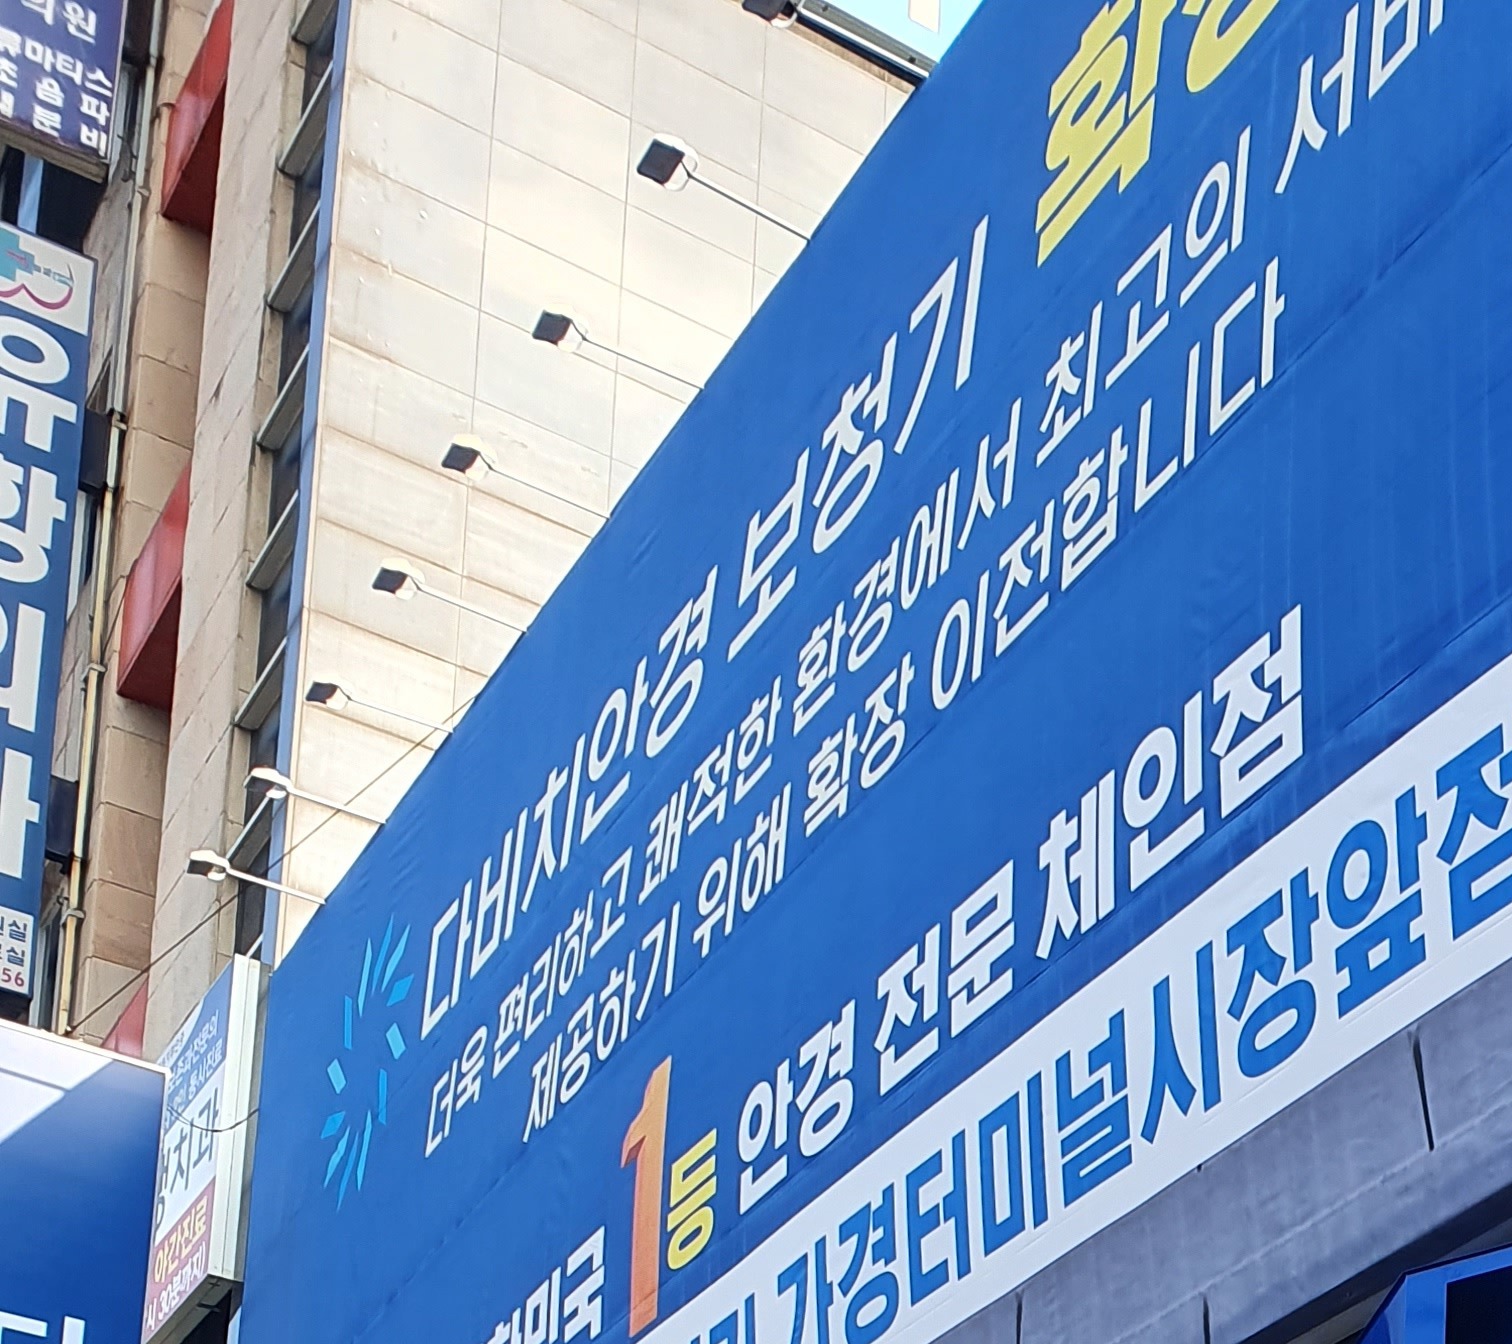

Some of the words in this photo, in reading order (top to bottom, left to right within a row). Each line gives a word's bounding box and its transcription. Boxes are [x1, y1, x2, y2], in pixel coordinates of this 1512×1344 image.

[420, 565, 718, 1040] 다비치안경
[727, 215, 990, 660] 보청기
[425, 1018, 489, 1159] 더욱
[491, 845, 633, 1080] 편리하고
[636, 672, 781, 904] 쾌적한
[791, 418, 1022, 739] 환경에서
[1034, 127, 1252, 464] 최고의
[521, 914, 679, 1144] 제공하기
[691, 780, 791, 961] 위해
[804, 662, 916, 837] 확장
[930, 256, 1287, 712] 이전합니다
[737, 998, 856, 1216] 안경
[873, 858, 1017, 1098] 전문
[1035, 603, 1304, 961] 체인점
